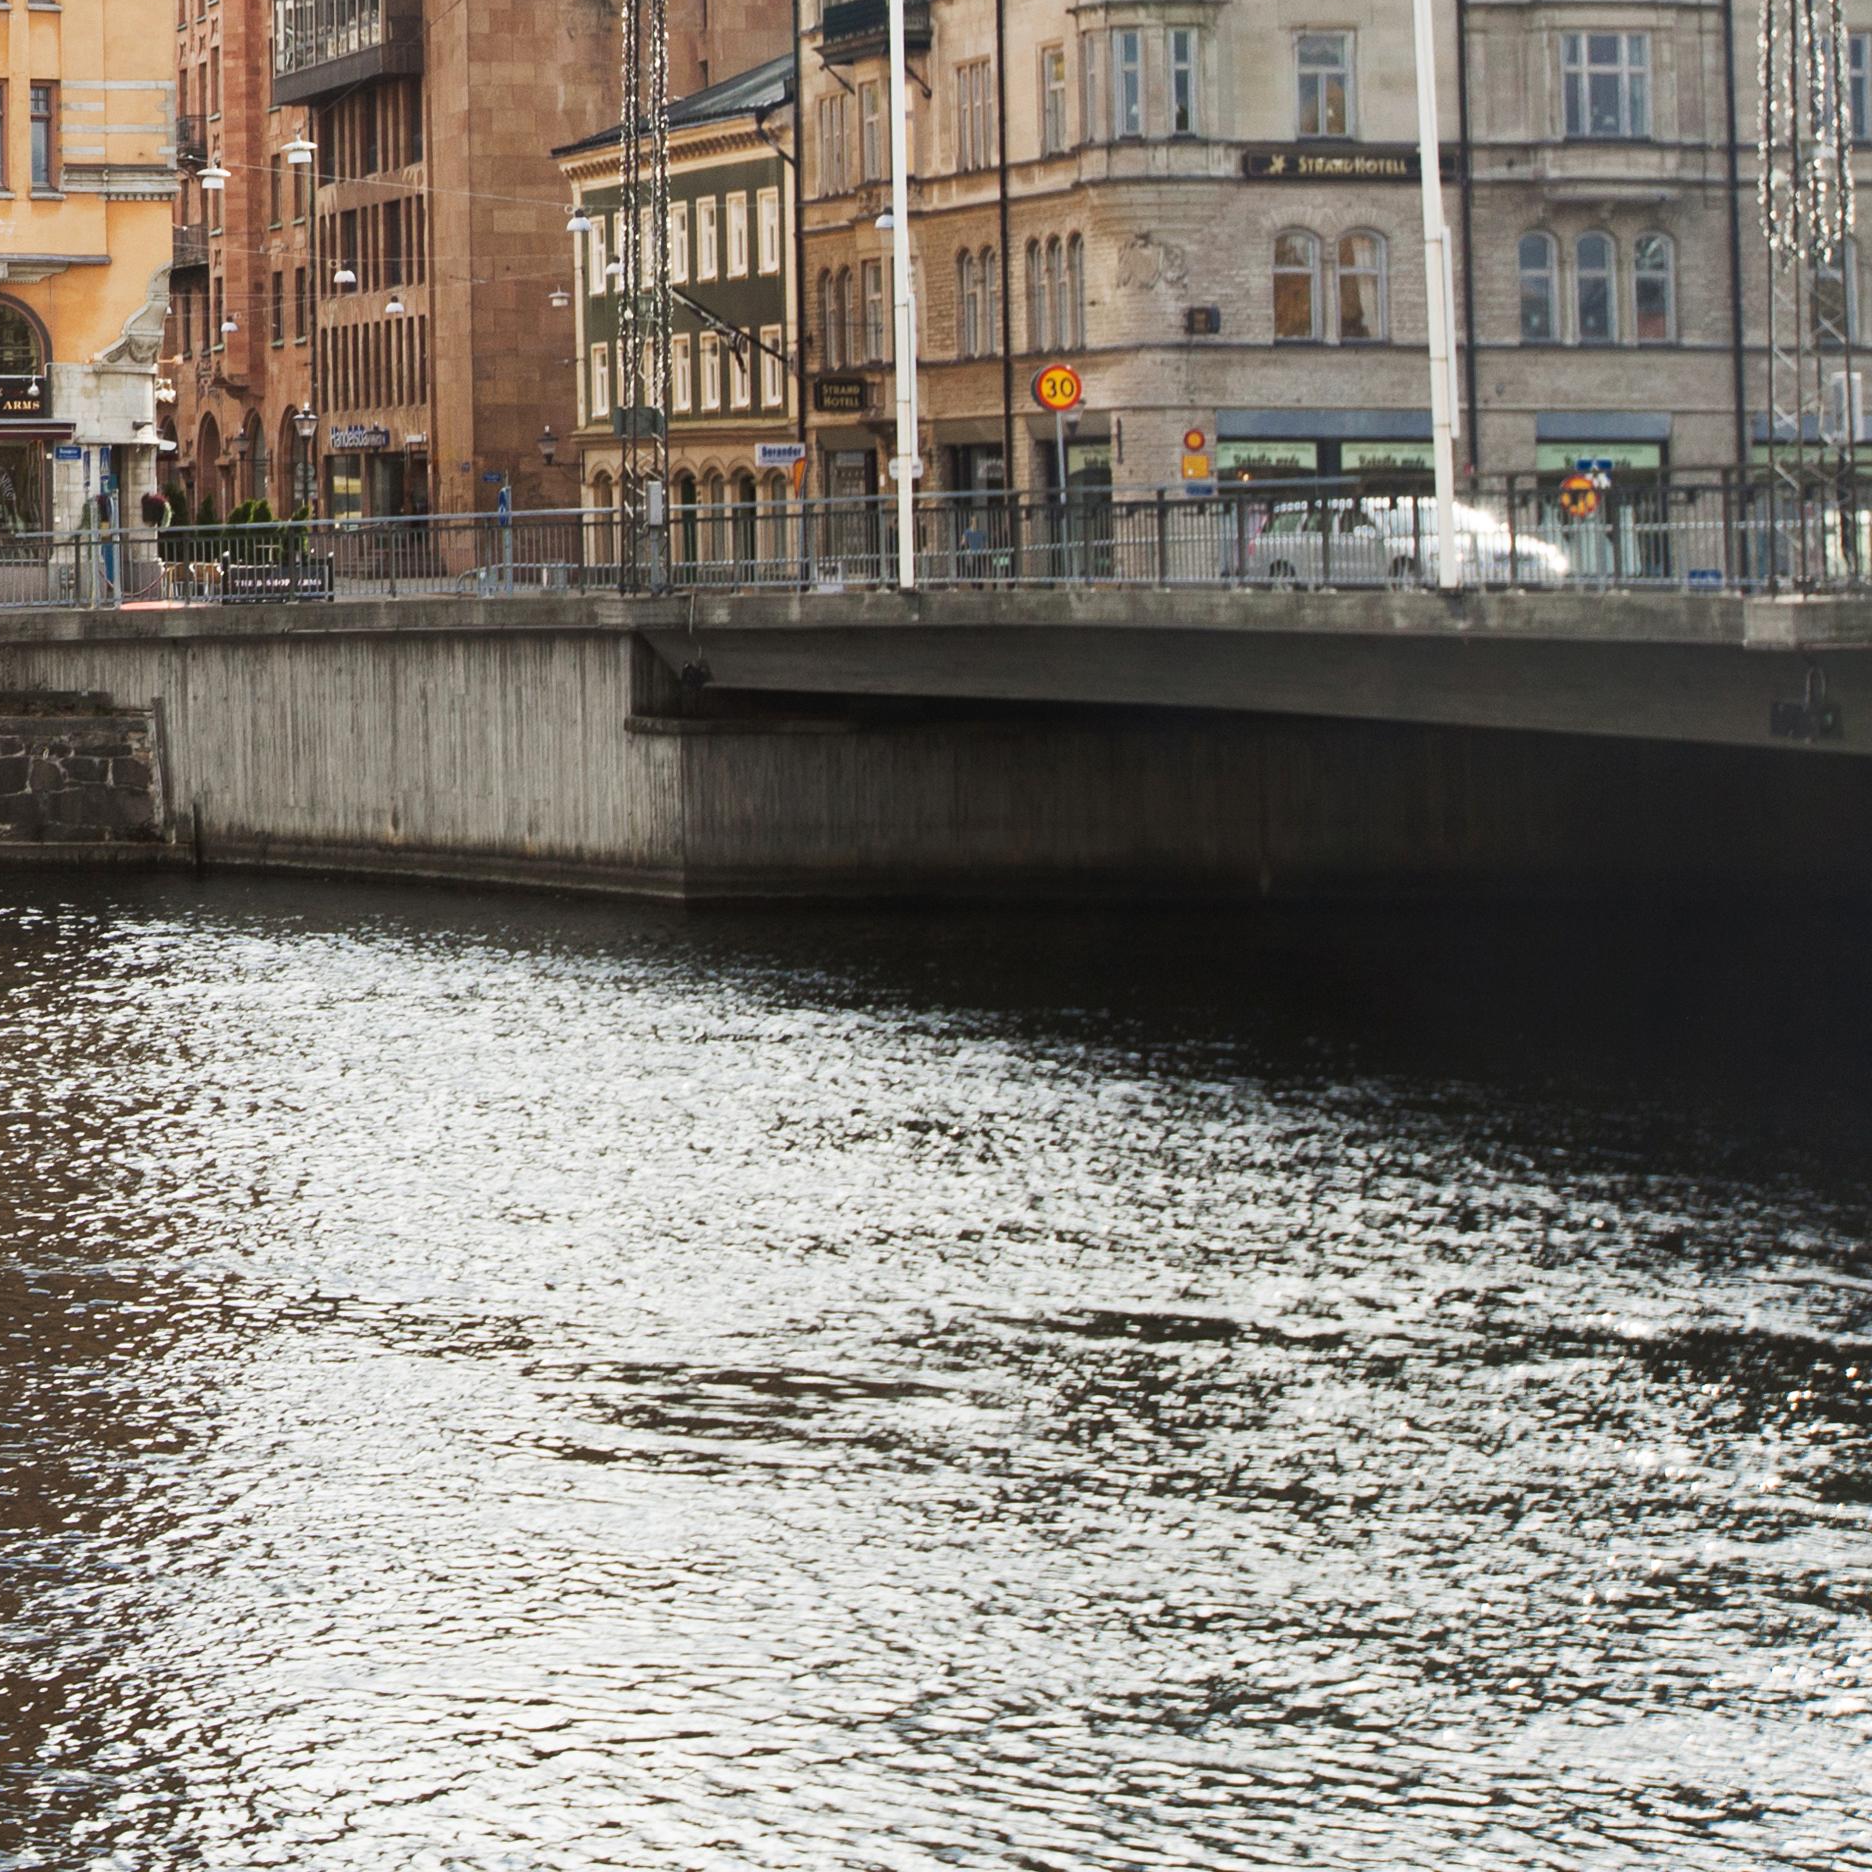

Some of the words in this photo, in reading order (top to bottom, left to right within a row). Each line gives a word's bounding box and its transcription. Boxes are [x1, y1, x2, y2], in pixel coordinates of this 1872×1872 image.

[1298, 155, 1354, 174] STRAND
[1355, 156, 1407, 174] HOTELL
[822, 384, 861, 395] STRAND
[1045, 378, 1075, 399] 30
[3, 400, 41, 410] ARMS
[823, 396, 860, 408] HOTELL
[330, 425, 386, 448] Handelsba
